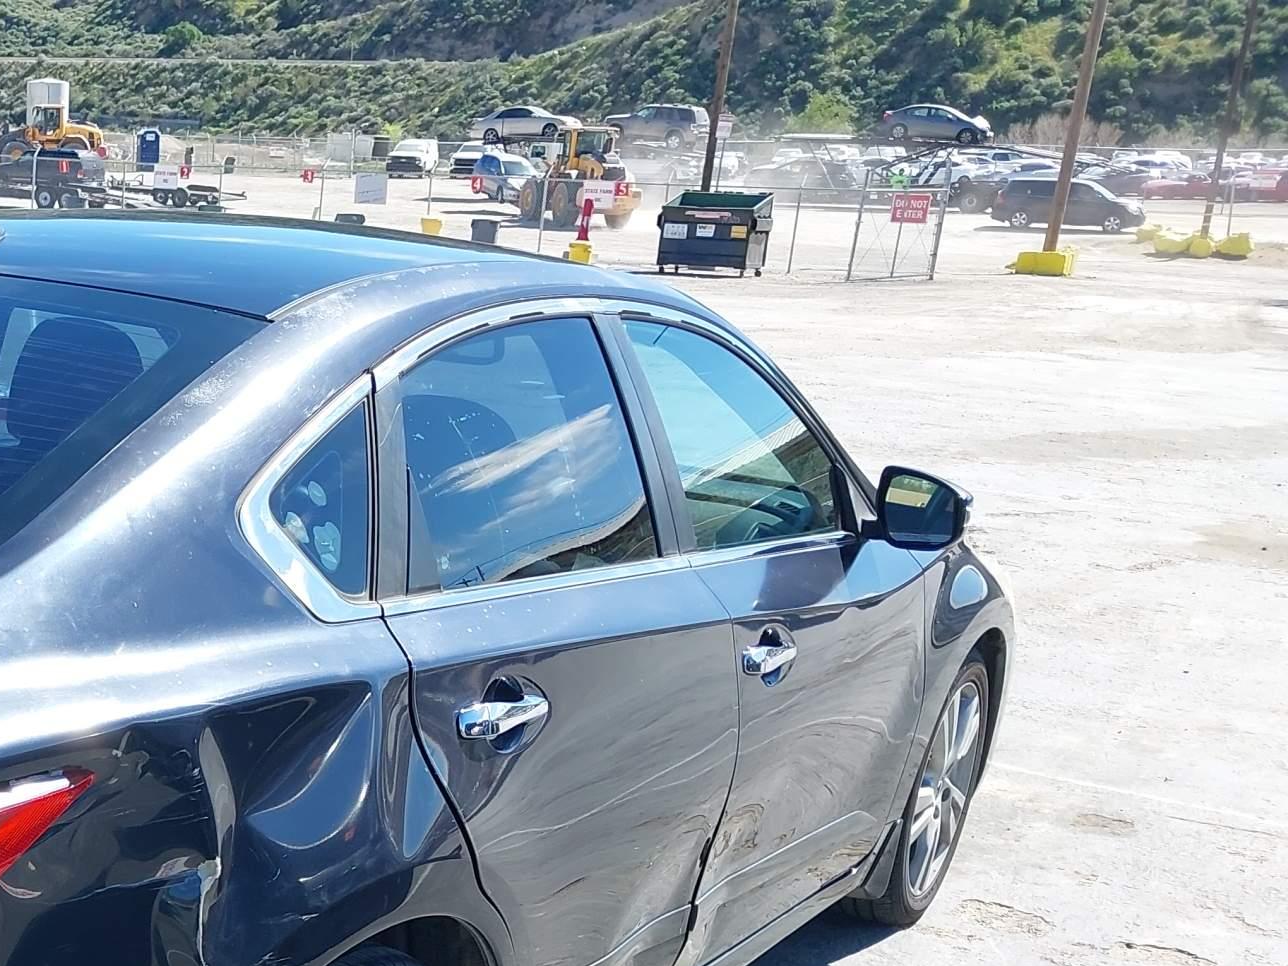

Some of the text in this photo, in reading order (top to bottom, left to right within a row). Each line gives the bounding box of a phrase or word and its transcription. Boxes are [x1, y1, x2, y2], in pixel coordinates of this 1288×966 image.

[619, 183, 628, 195] 5
[895, 200, 928, 209] DO NOT
[896, 209, 924, 219] ENTER
